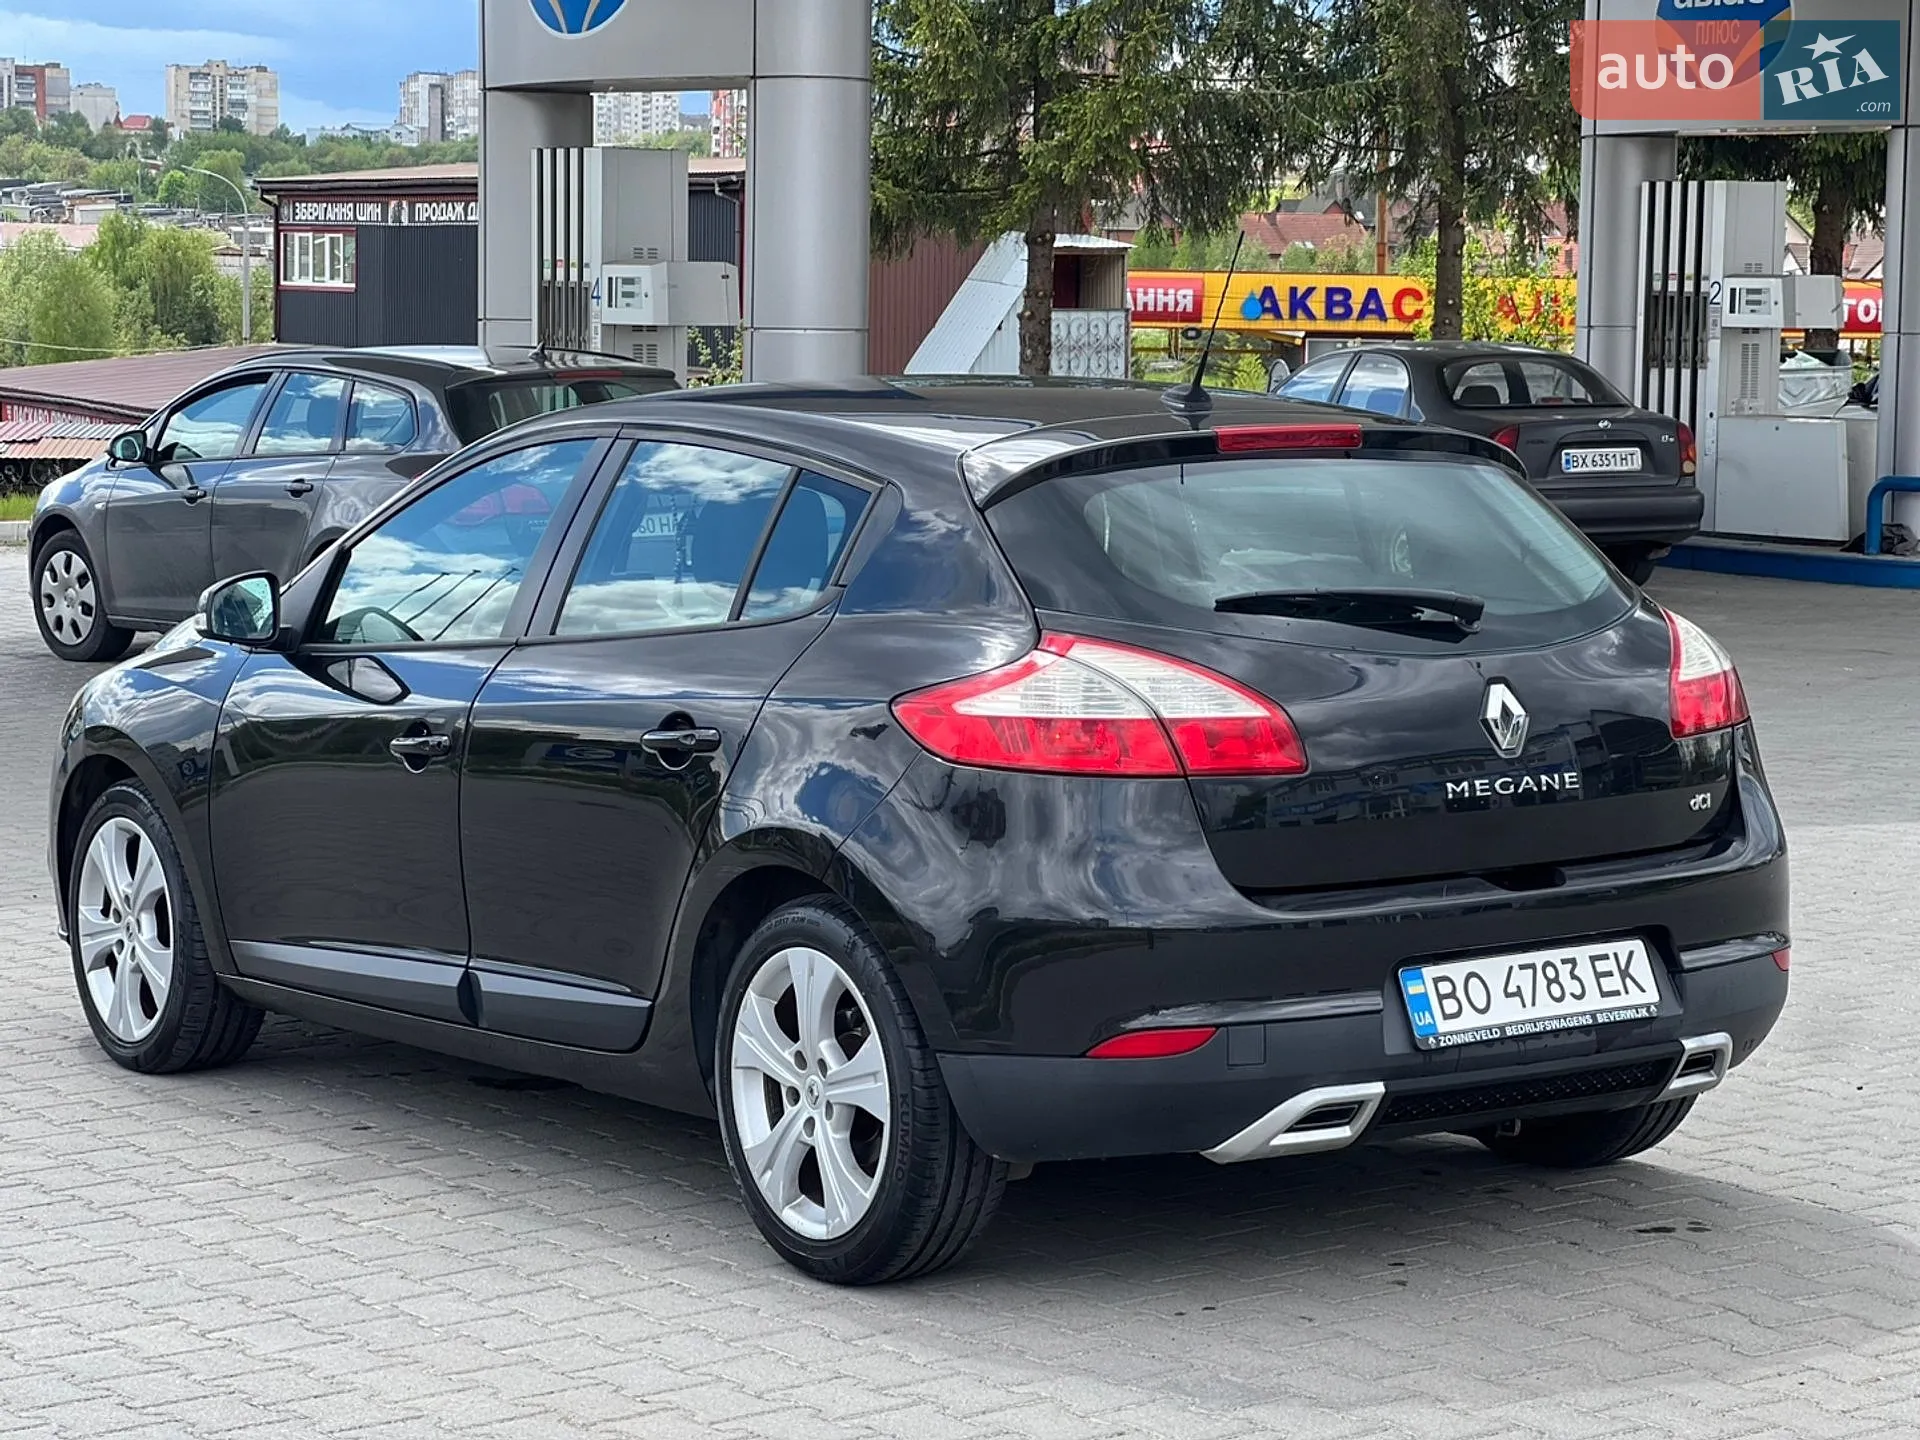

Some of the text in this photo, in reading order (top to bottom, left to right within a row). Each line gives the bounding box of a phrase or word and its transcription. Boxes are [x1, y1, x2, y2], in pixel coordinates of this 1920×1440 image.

[1694, 19, 1741, 46] ПЛЮС
[294, 201, 382, 222] ЗБЕРІГАННЯ ШИН
[414, 201, 479, 222] ПРОДАЖ Д
[591, 277, 601, 307] 4
[1709, 281, 1722, 306] 2
[1620, 453, 1636, 467] HT
[1446, 771, 1580, 799] MEGANE
[1432, 949, 1647, 1021] BO 4783 EK
[1413, 1011, 1435, 1026] UA
[1438, 1028, 1501, 1047] ZONNEVELD
[1505, 1014, 1593, 1036] BEDRIJFSWAGENS
[895, 1092, 911, 1181] KUMHO
